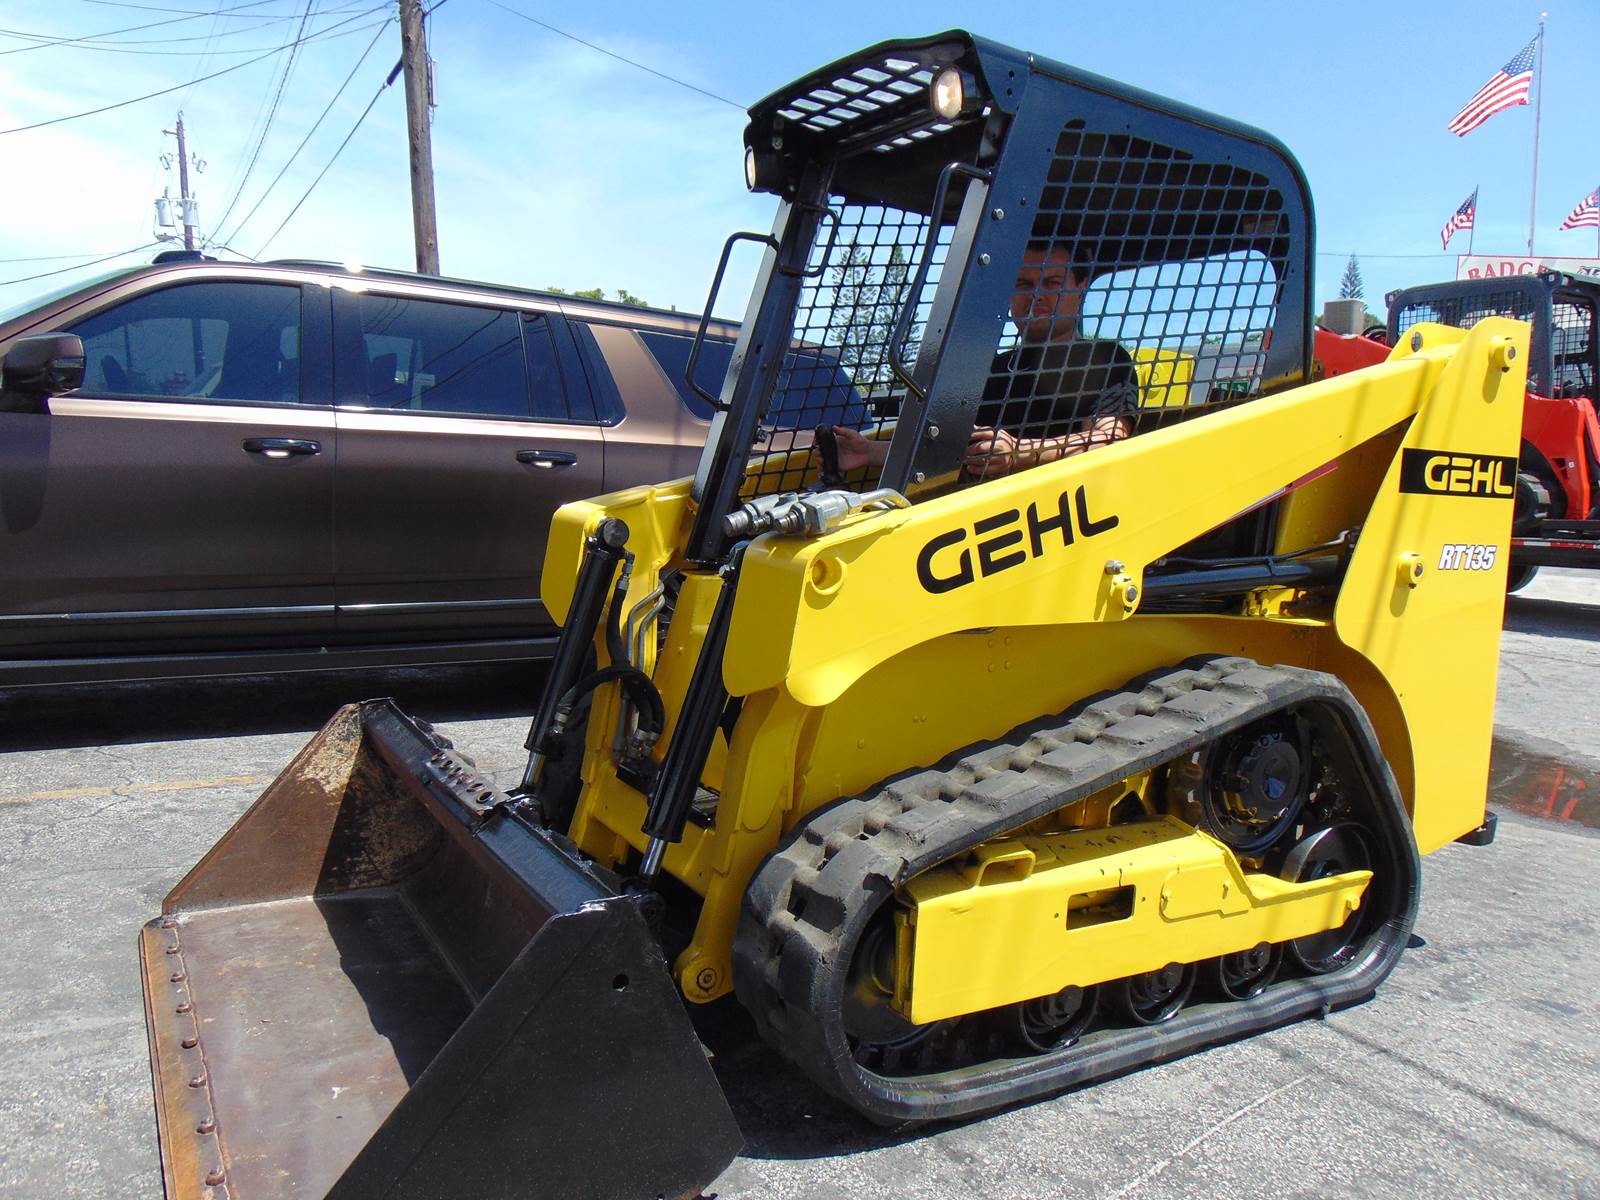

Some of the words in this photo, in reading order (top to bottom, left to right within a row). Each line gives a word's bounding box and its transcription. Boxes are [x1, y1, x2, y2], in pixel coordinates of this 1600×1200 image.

[1424, 455, 1513, 495] GEHL
[916, 484, 1119, 594] GEHL
[1438, 544, 1497, 571] RT135
